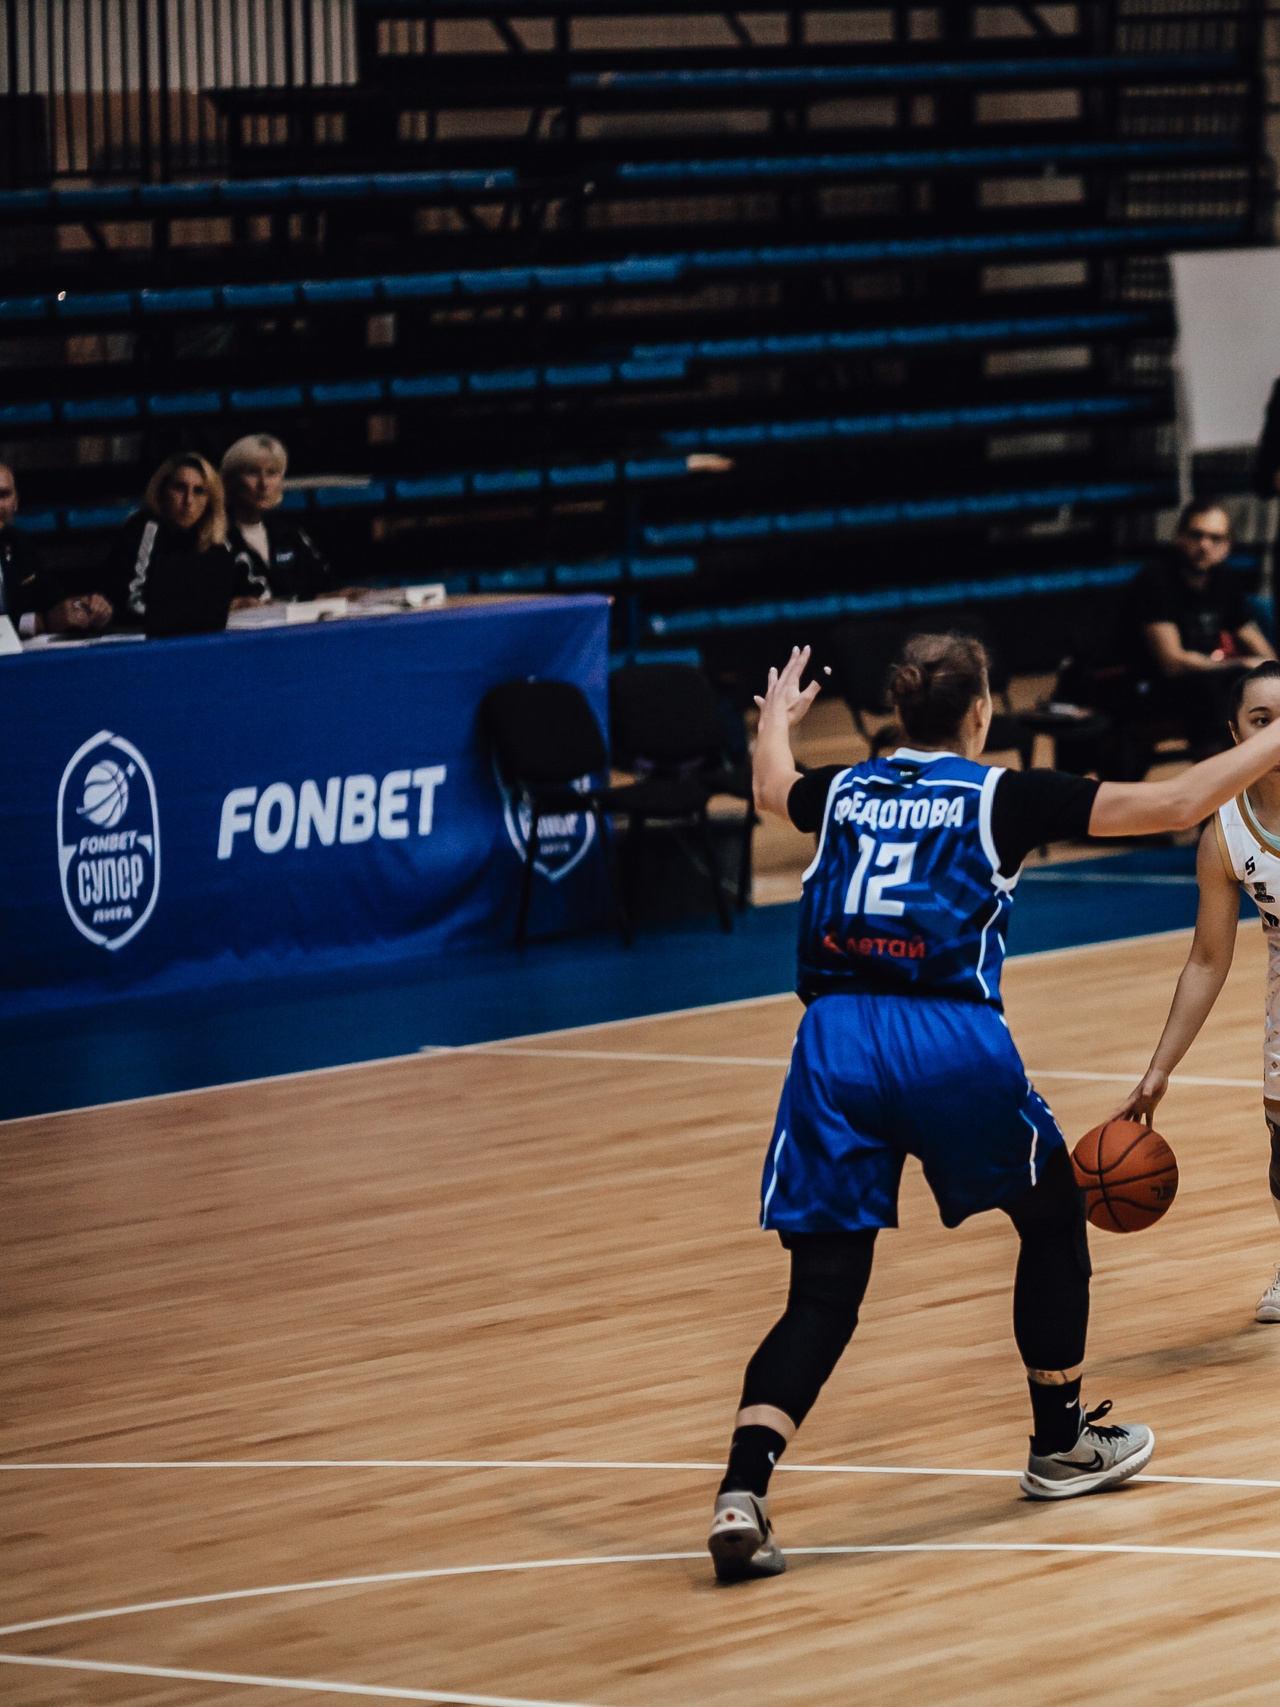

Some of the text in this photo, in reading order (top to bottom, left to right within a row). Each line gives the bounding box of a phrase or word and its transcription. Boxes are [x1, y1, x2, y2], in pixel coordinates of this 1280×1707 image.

[217, 765, 446, 859] FONBET
[834, 792, 965, 831] ФЕДОТОВА
[79, 829, 138, 856] FONBET
[77, 853, 144, 906] СУПЕР
[844, 833, 917, 916] 12
